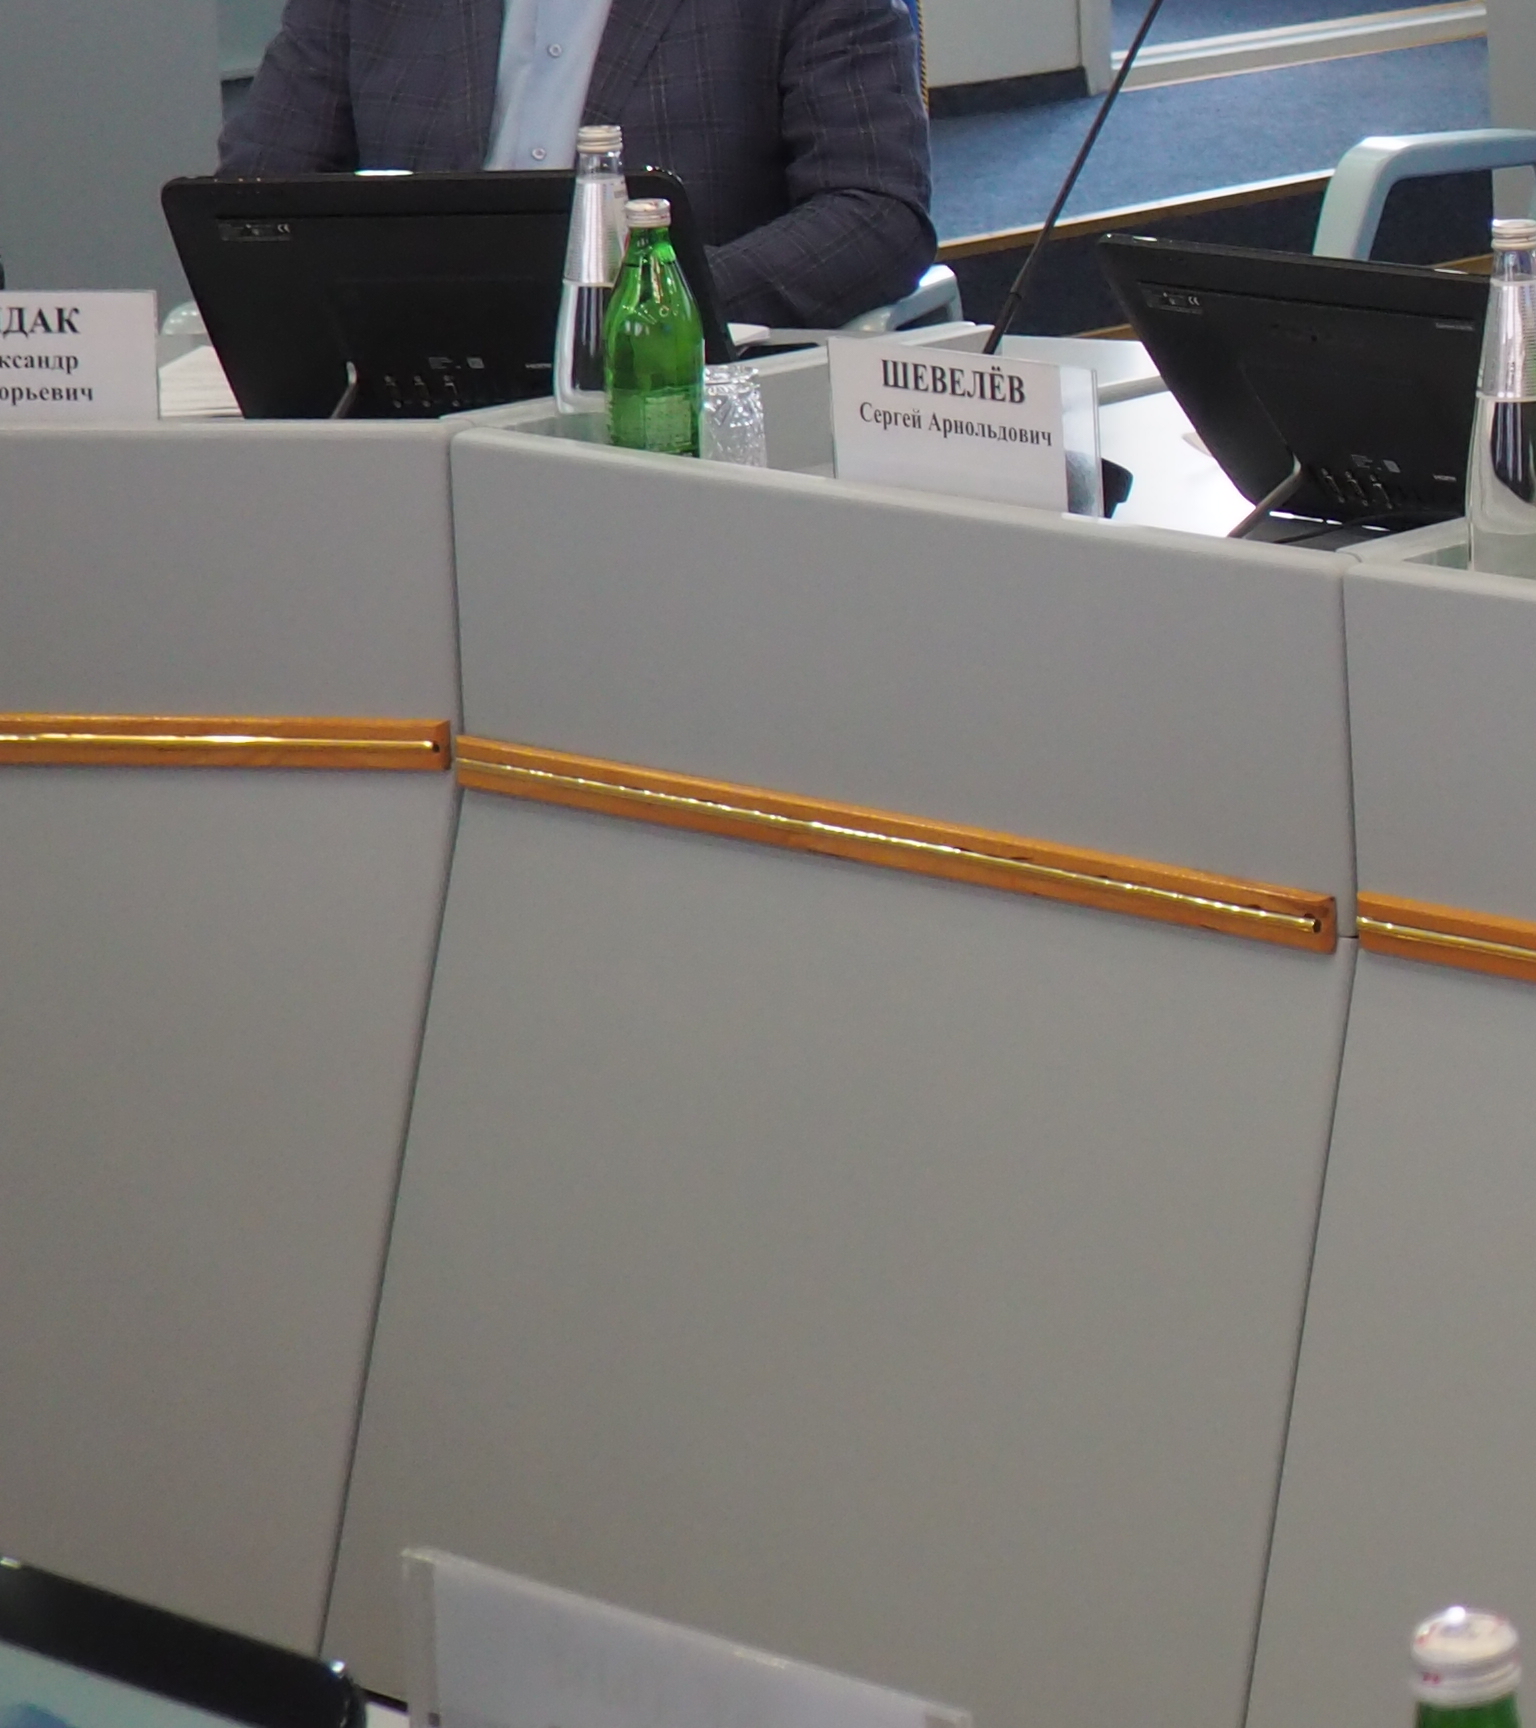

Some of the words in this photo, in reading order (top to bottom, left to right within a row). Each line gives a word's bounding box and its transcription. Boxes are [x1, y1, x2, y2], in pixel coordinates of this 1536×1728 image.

[0, 307, 80, 338] ДАК
[881, 358, 1026, 404] ШЕВЕЛЁВ
[859, 401, 922, 431] Сергей
[928, 412, 1053, 447] Арнольдович
